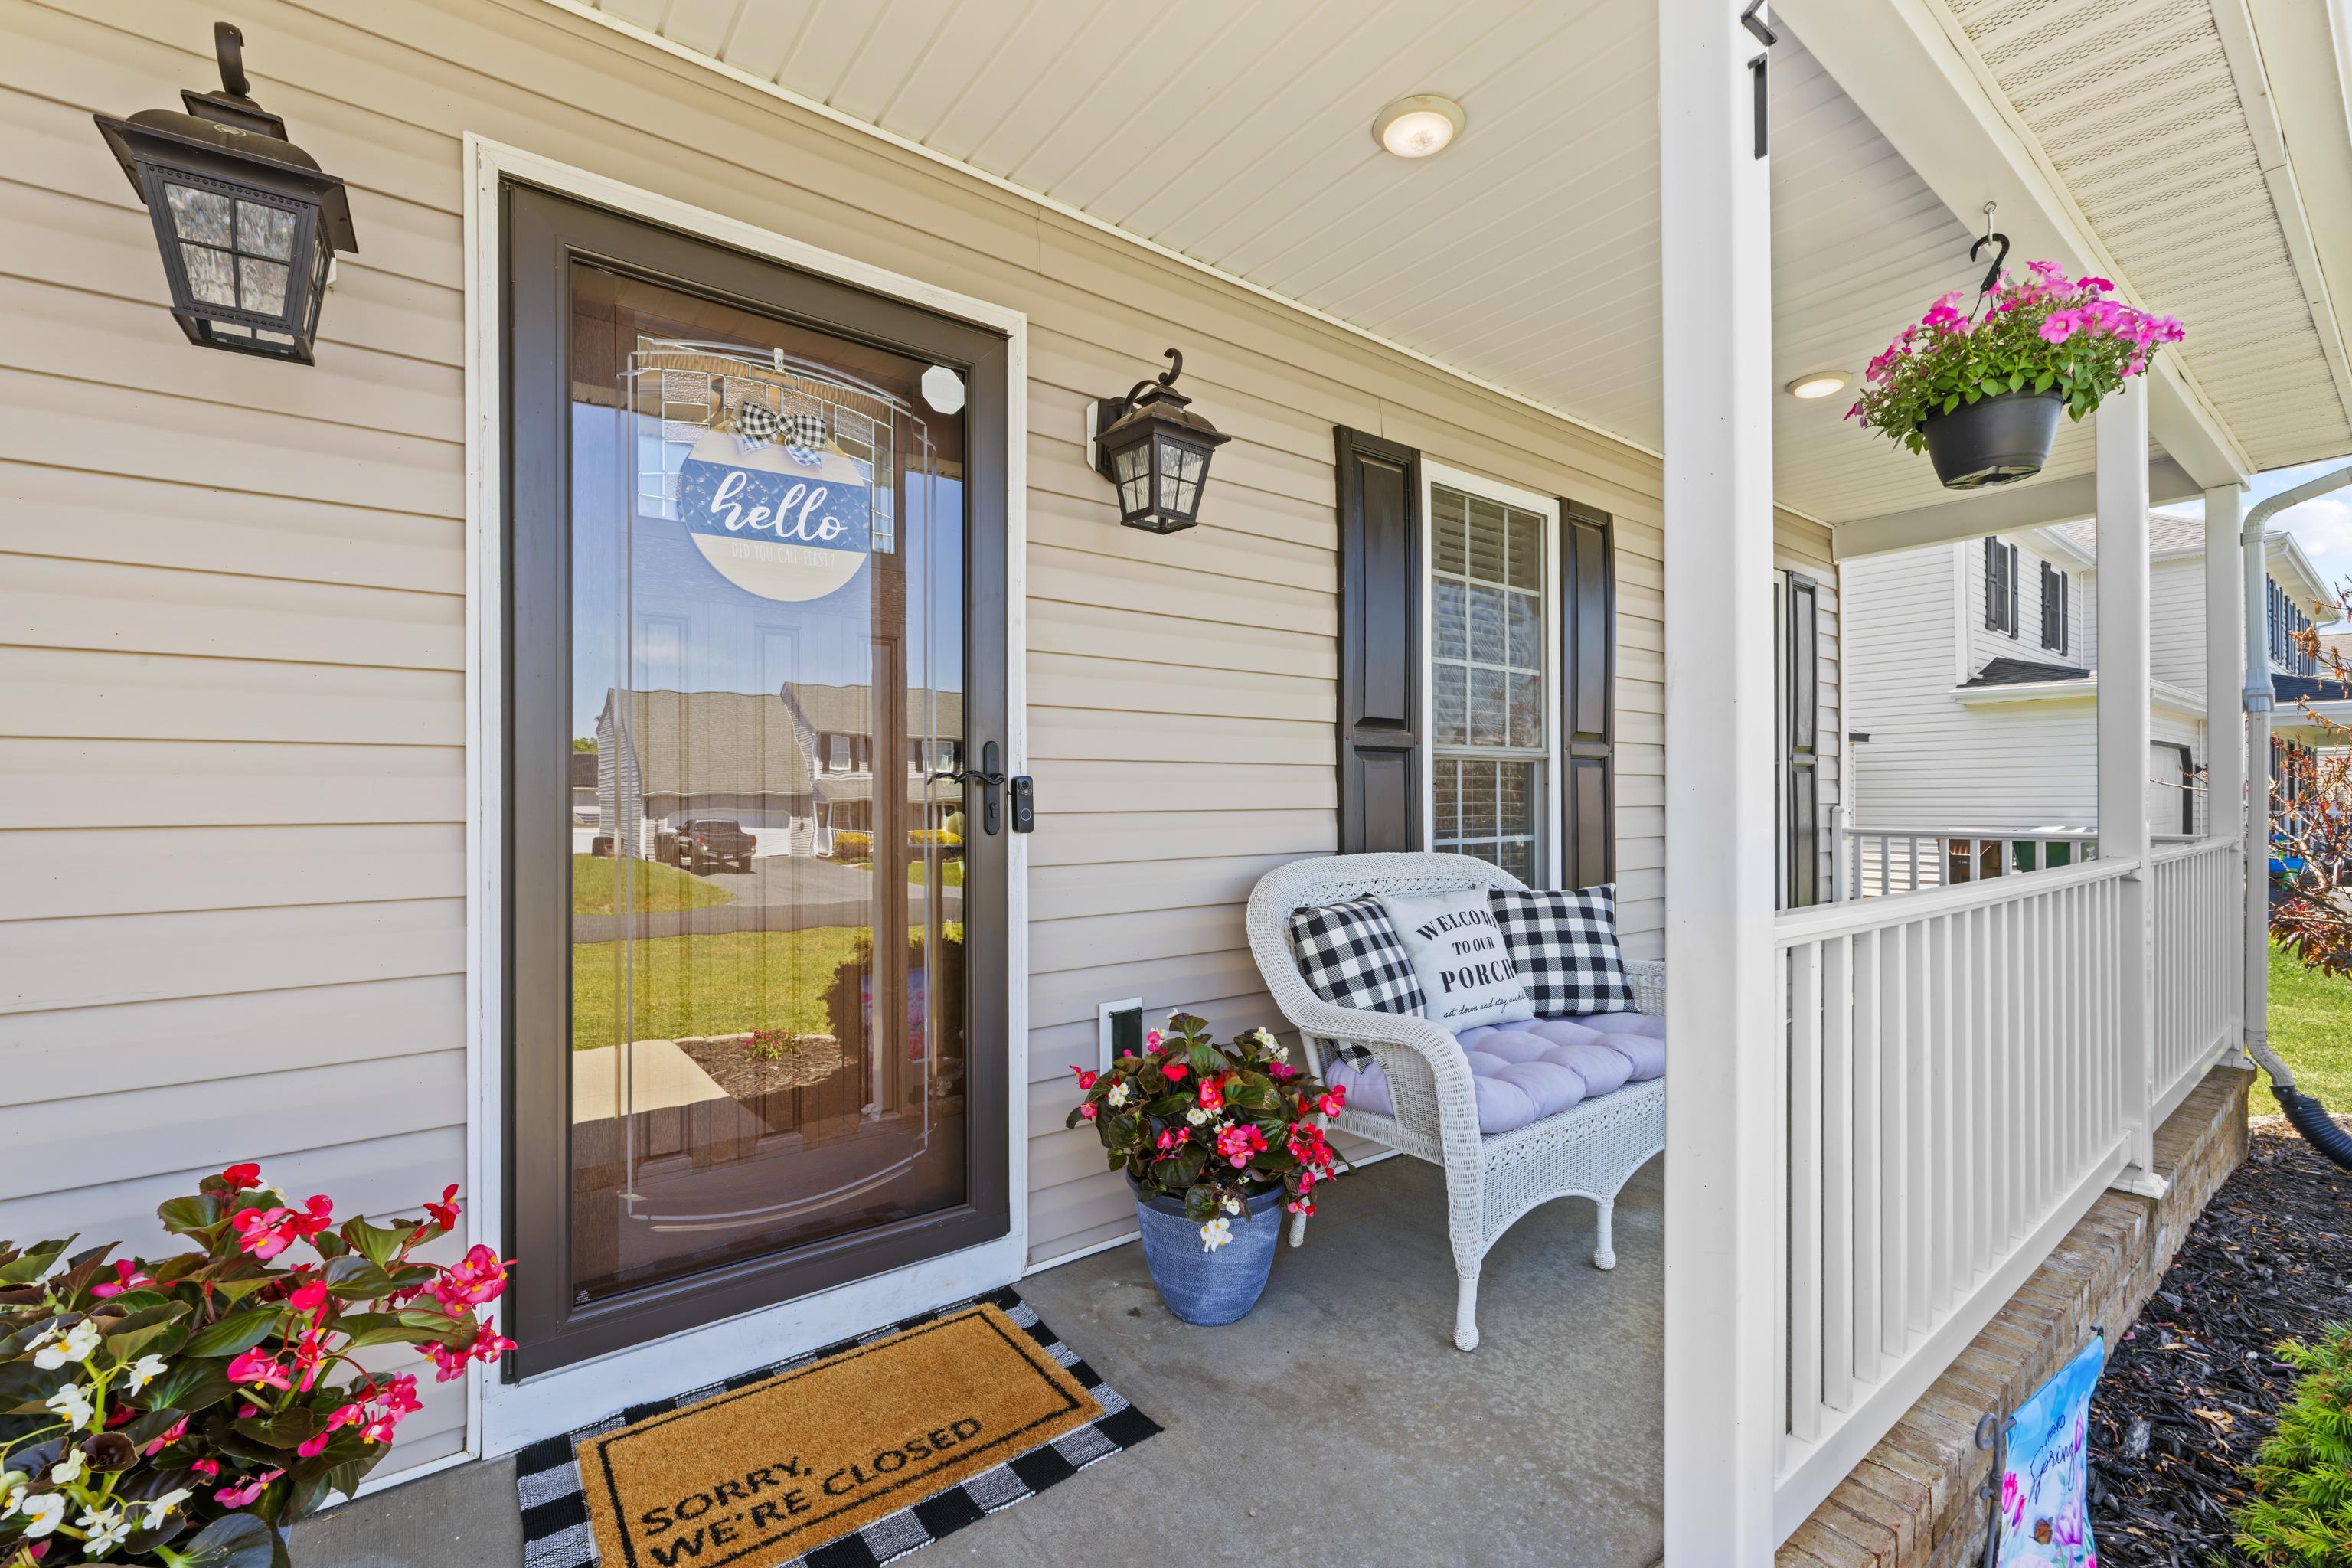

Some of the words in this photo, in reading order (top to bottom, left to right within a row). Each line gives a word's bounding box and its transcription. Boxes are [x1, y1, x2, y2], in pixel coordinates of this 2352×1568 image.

[710, 471, 848, 541] hello
[732, 542, 750, 558] DID
[754, 544, 773, 562] YOU
[777, 547, 799, 564] CALL
[803, 550, 835, 570] FIRST?
[1452, 940, 1471, 956] TO
[1473, 936, 1495, 952] OUR
[1439, 959, 1515, 994] PORCH
[1458, 1004, 1479, 1015] down
[1480, 997, 1494, 1010] and
[1494, 997, 1509, 1014] stay
[642, 1454, 813, 1537] SORRY,
[651, 1489, 812, 1567] WE'RE
[823, 1416, 982, 1496] CLOSED
